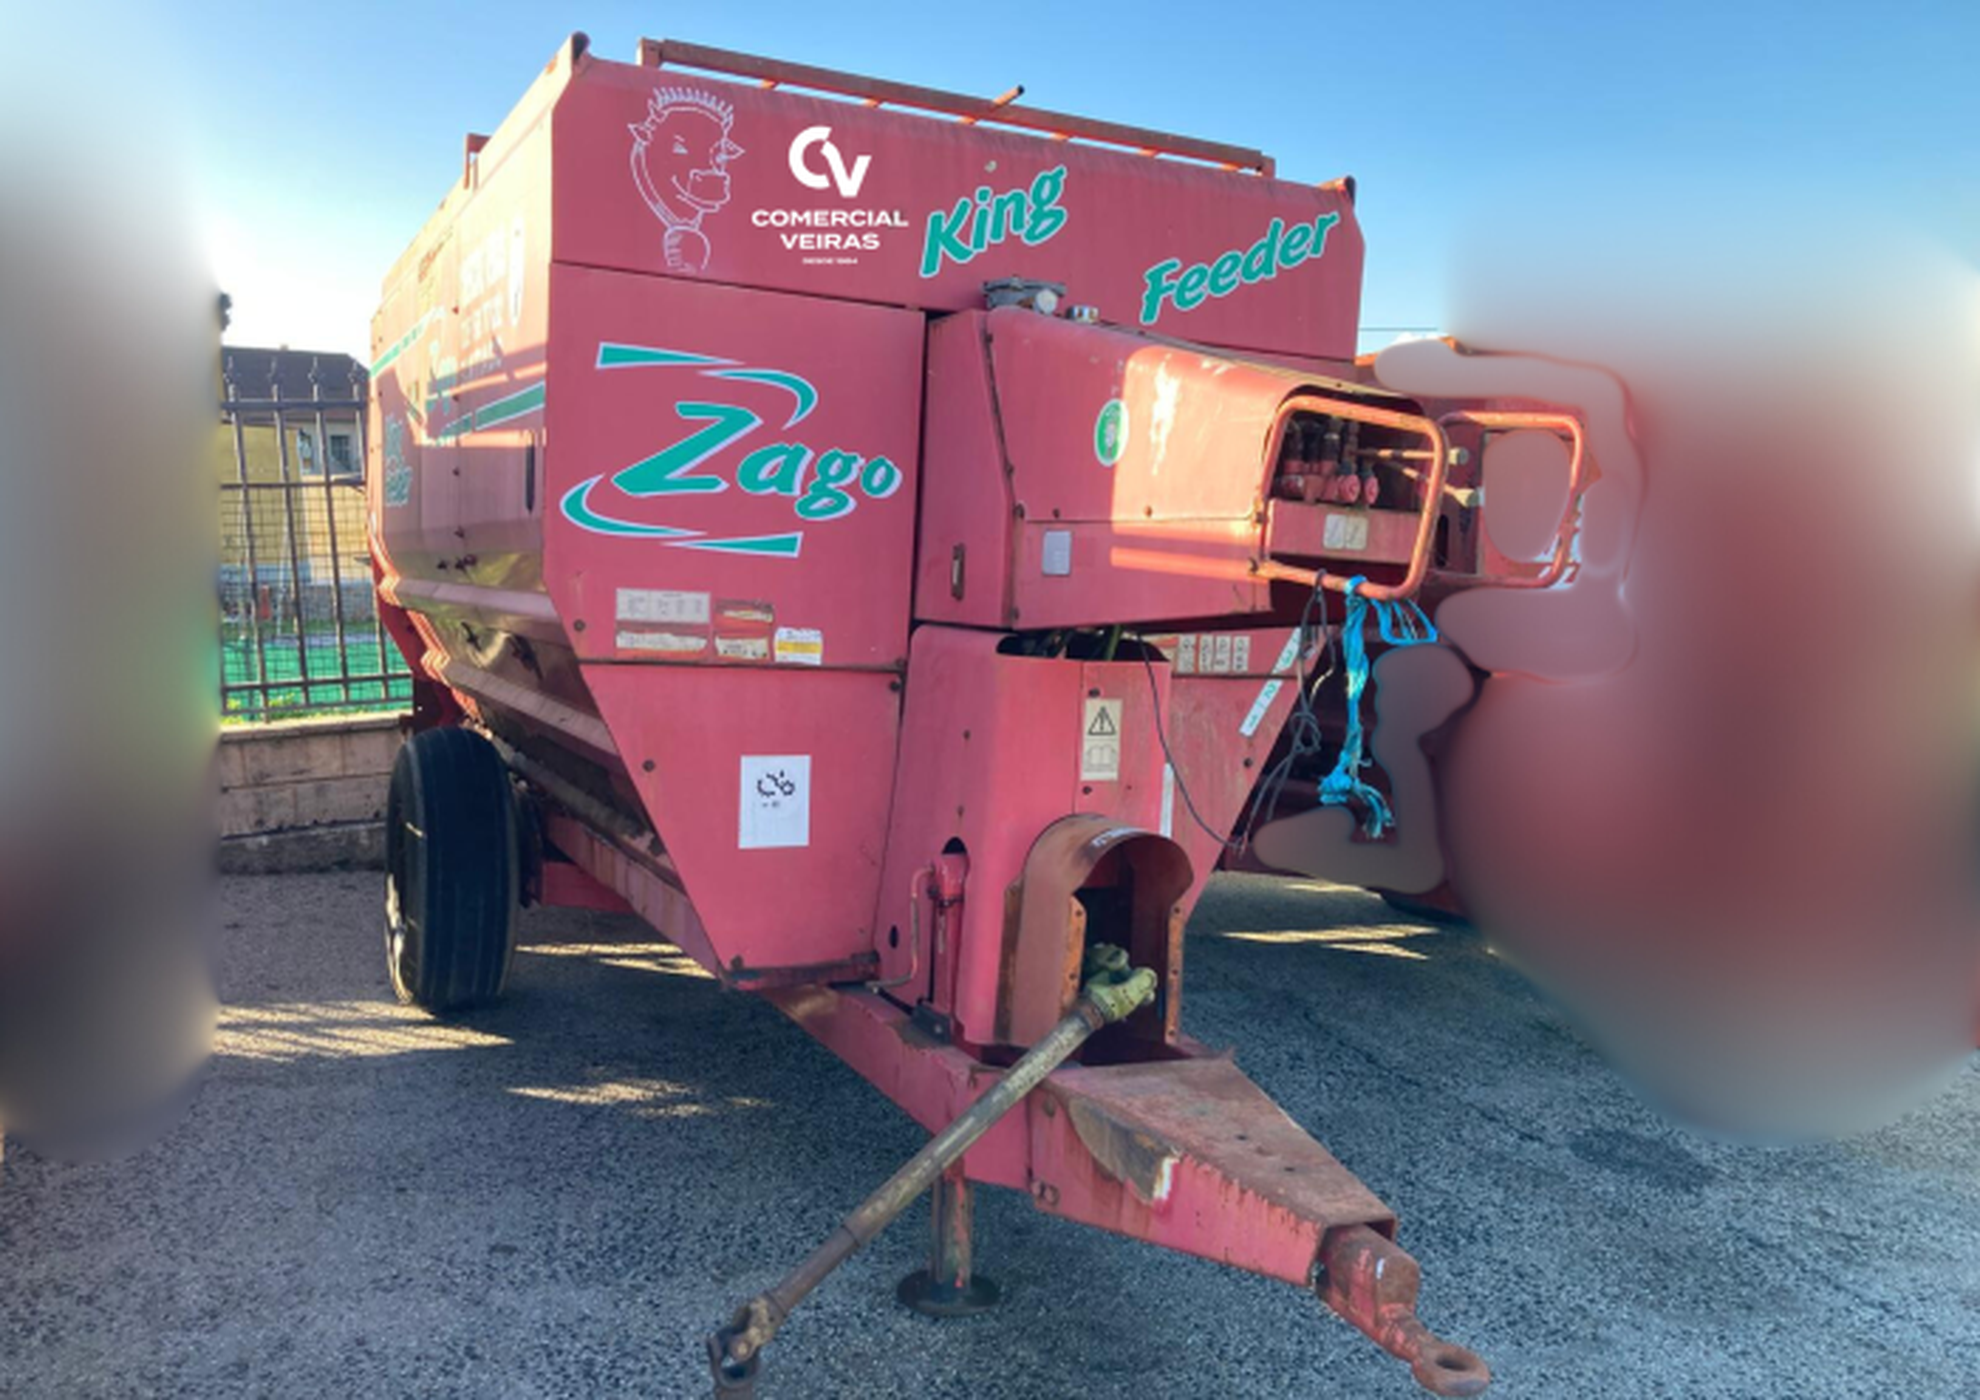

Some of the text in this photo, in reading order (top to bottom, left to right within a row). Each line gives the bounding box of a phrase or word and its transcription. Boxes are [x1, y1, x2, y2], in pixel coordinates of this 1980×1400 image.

[920, 165, 1068, 277] King
[1140, 210, 1340, 325] Feeder
[611, 401, 903, 520] Zago
